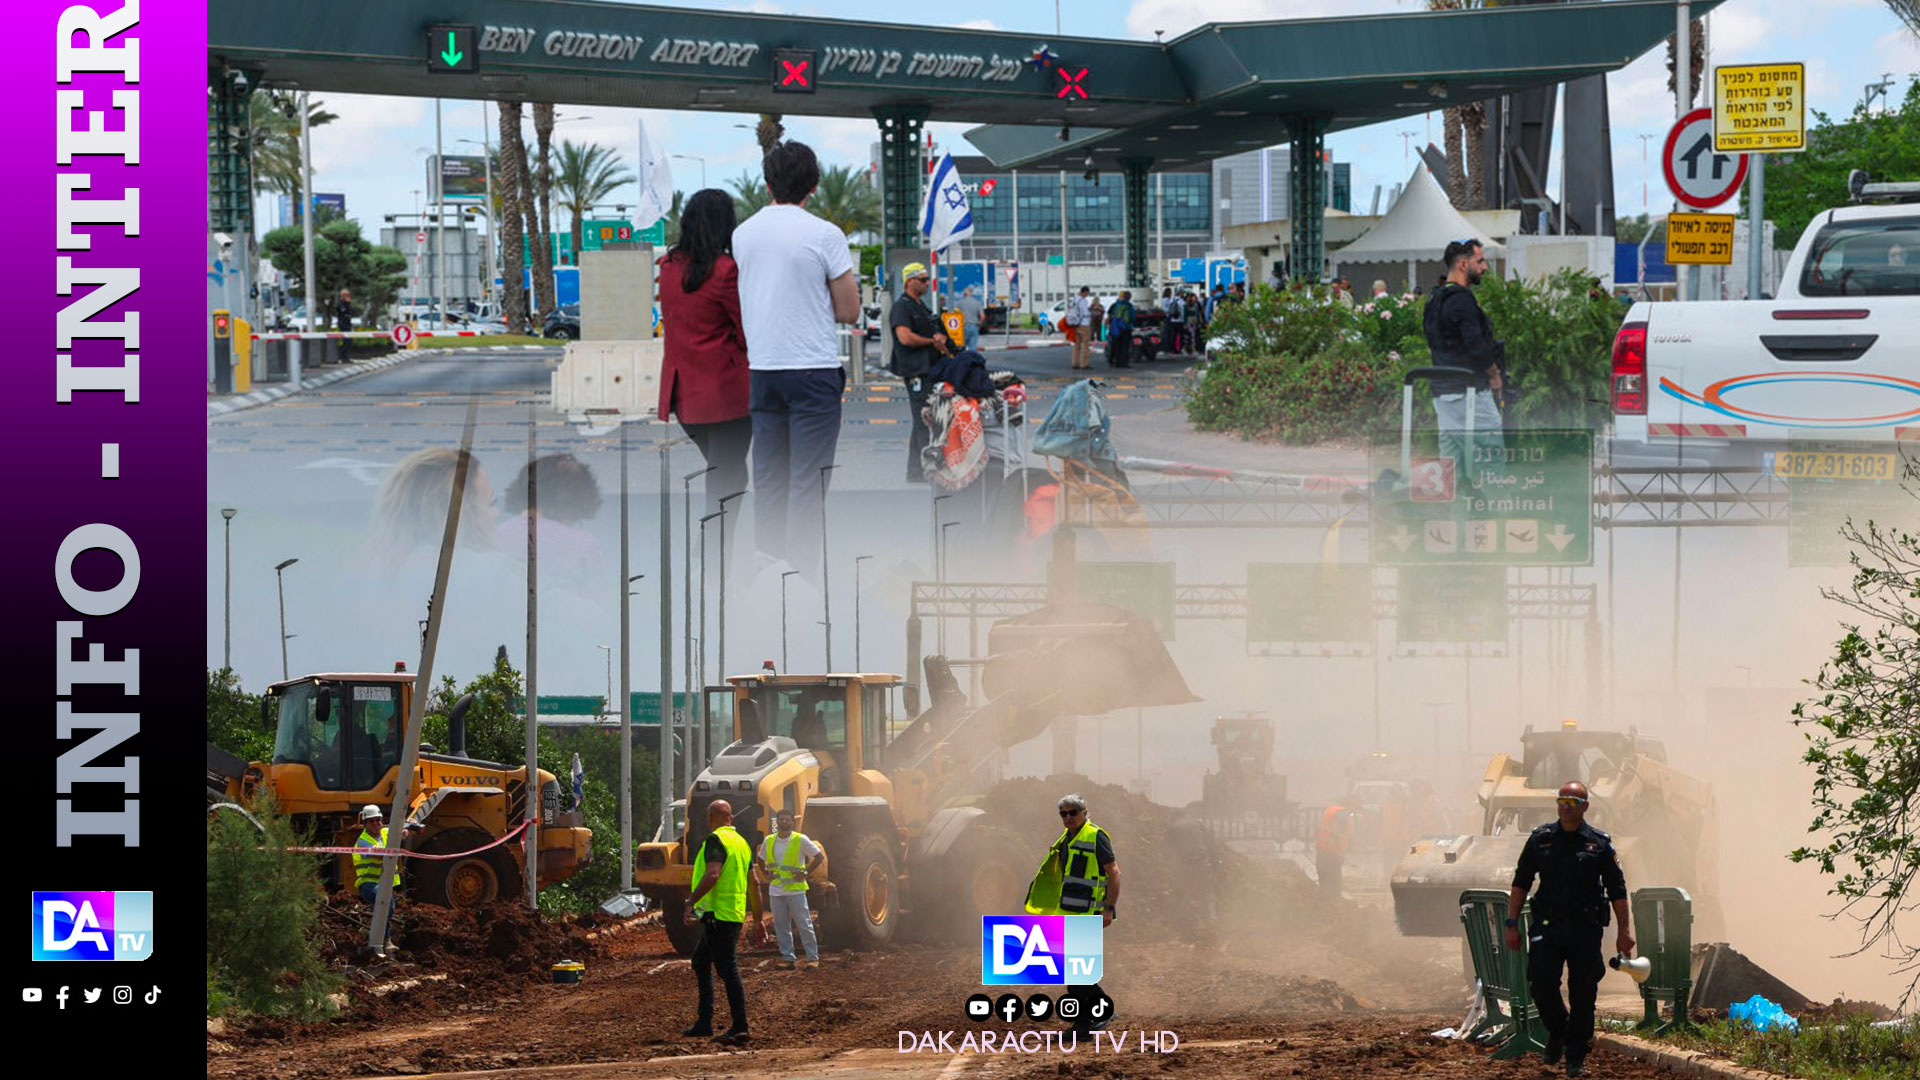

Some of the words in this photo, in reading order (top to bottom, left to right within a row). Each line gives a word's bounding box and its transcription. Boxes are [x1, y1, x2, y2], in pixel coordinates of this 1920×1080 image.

[478, 25, 536, 54] BEN
[543, 30, 644, 61] GURION
[650, 38, 759, 67] AIRPORT
[818, 46, 876, 76] גוריון
[875, 50, 902, 79] בן
[906, 52, 984, 78] התעופה
[981, 53, 1023, 81] נמל
[1721, 72, 1753, 85] לפניך
[1759, 71, 1798, 82] מחסום
[1726, 87, 1770, 99] בזהירות
[1777, 86, 1793, 96] סע
[1726, 102, 1767, 114] הוראות
[1773, 100, 1793, 111] לפי
[1733, 116, 1785, 128] המאבטח
[1653, 333, 1692, 343] TOYOTA
[1420, 461, 1445, 495] 3
[1462, 496, 1554, 512] Terminal
[438, 775, 501, 786] VOLVO
